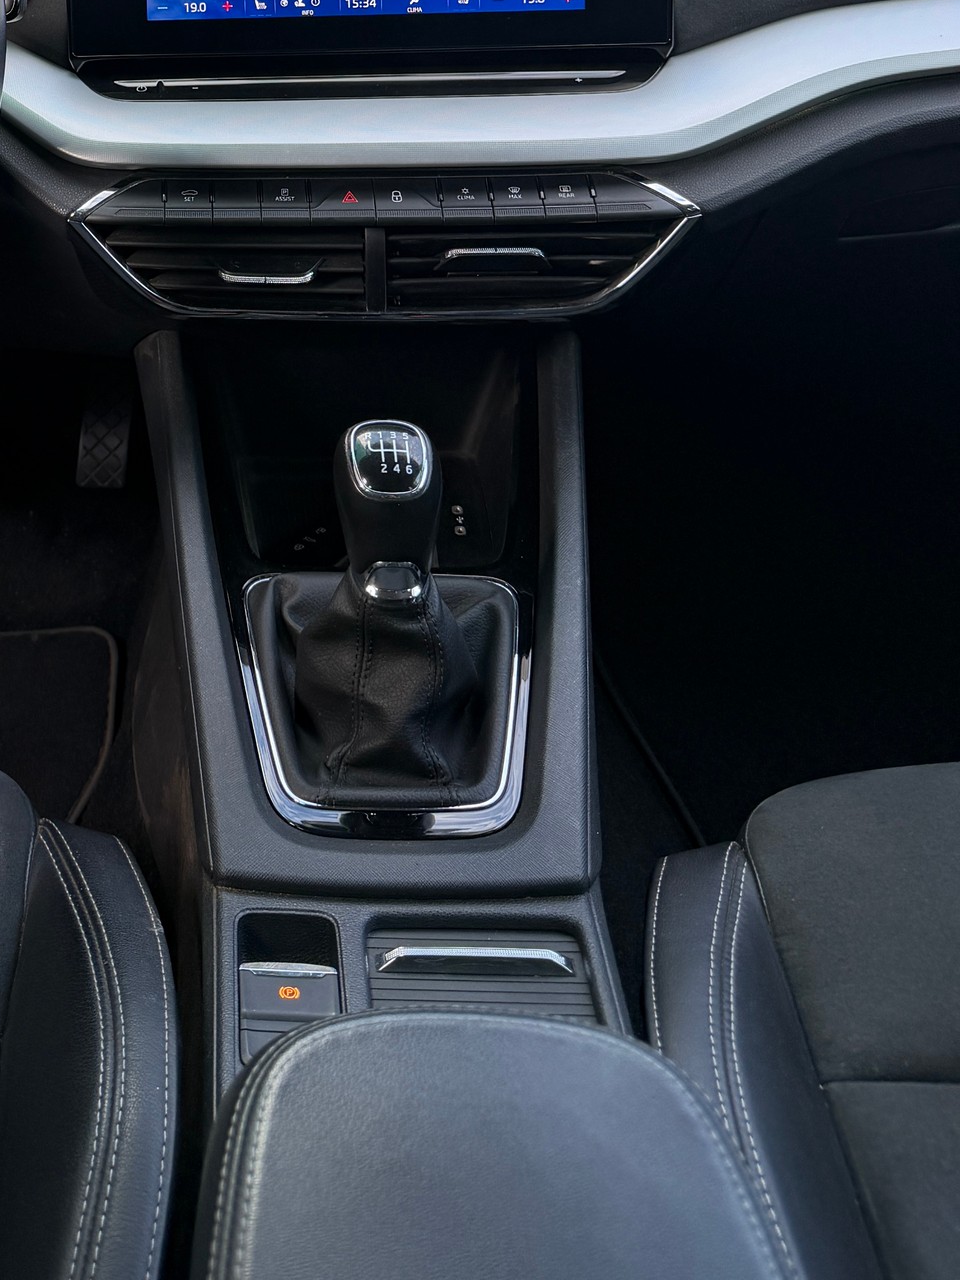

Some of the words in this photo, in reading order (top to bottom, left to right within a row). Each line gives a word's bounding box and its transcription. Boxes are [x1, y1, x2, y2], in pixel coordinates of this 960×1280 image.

[184, 2, 207, 12] 19.0
[381, 464, 387, 473] 2
[393, 464, 400, 473] 4
[406, 465, 413, 474] 6
